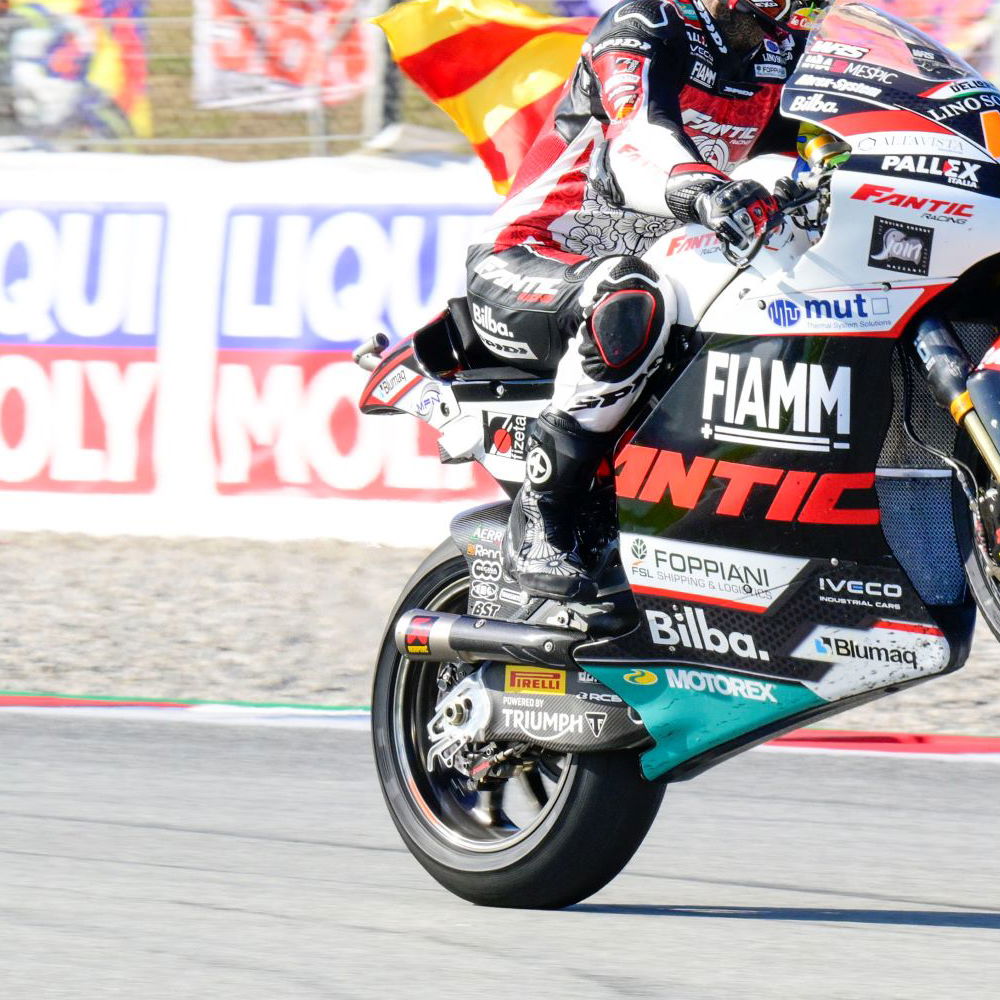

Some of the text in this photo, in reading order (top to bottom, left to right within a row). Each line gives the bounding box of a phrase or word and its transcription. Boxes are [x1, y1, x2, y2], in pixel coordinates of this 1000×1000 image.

[691, 61, 717, 86] FIAMM
[843, 61, 899, 85] MESPIC
[789, 93, 839, 113] Bilba.
[927, 97, 981, 122] LINO
[682, 108, 759, 139] FANTIC
[881, 155, 981, 182] PALLEX
[947, 176, 979, 189] ITALIA
[850, 183, 976, 217] FANTIC
[920, 212, 968, 225] RACING
[666, 231, 719, 257] FANTI
[222, 212, 490, 342] LIQU
[804, 293, 868, 319] mut
[472, 302, 515, 338] Bilba.
[833, 320, 858, 330] System
[859, 319, 892, 329] Solutions
[383, 370, 406, 395] Blumaq
[702, 350, 851, 435] FIAMM
[217, 362, 476, 491] MOL
[511, 416, 527, 461] fizeta
[614, 444, 881, 525] ANTIC
[632, 566, 654, 579] FSL
[656, 570, 706, 588] SHIPPING
[708, 582, 716, 590] &
[654, 549, 770, 587] FOPPIANI
[819, 577, 902, 598] IVECO
[472, 601, 501, 617] BST
[819, 596, 901, 611] INDUSTRIAL CARS
[645, 607, 770, 661] Bilba.
[834, 638, 918, 670] Blumaq
[510, 671, 561, 690] PIRELLI
[665, 668, 778, 704] MOTOREX
[502, 696, 545, 708] POWERED BY
[502, 708, 584, 739] TRIUMPH
